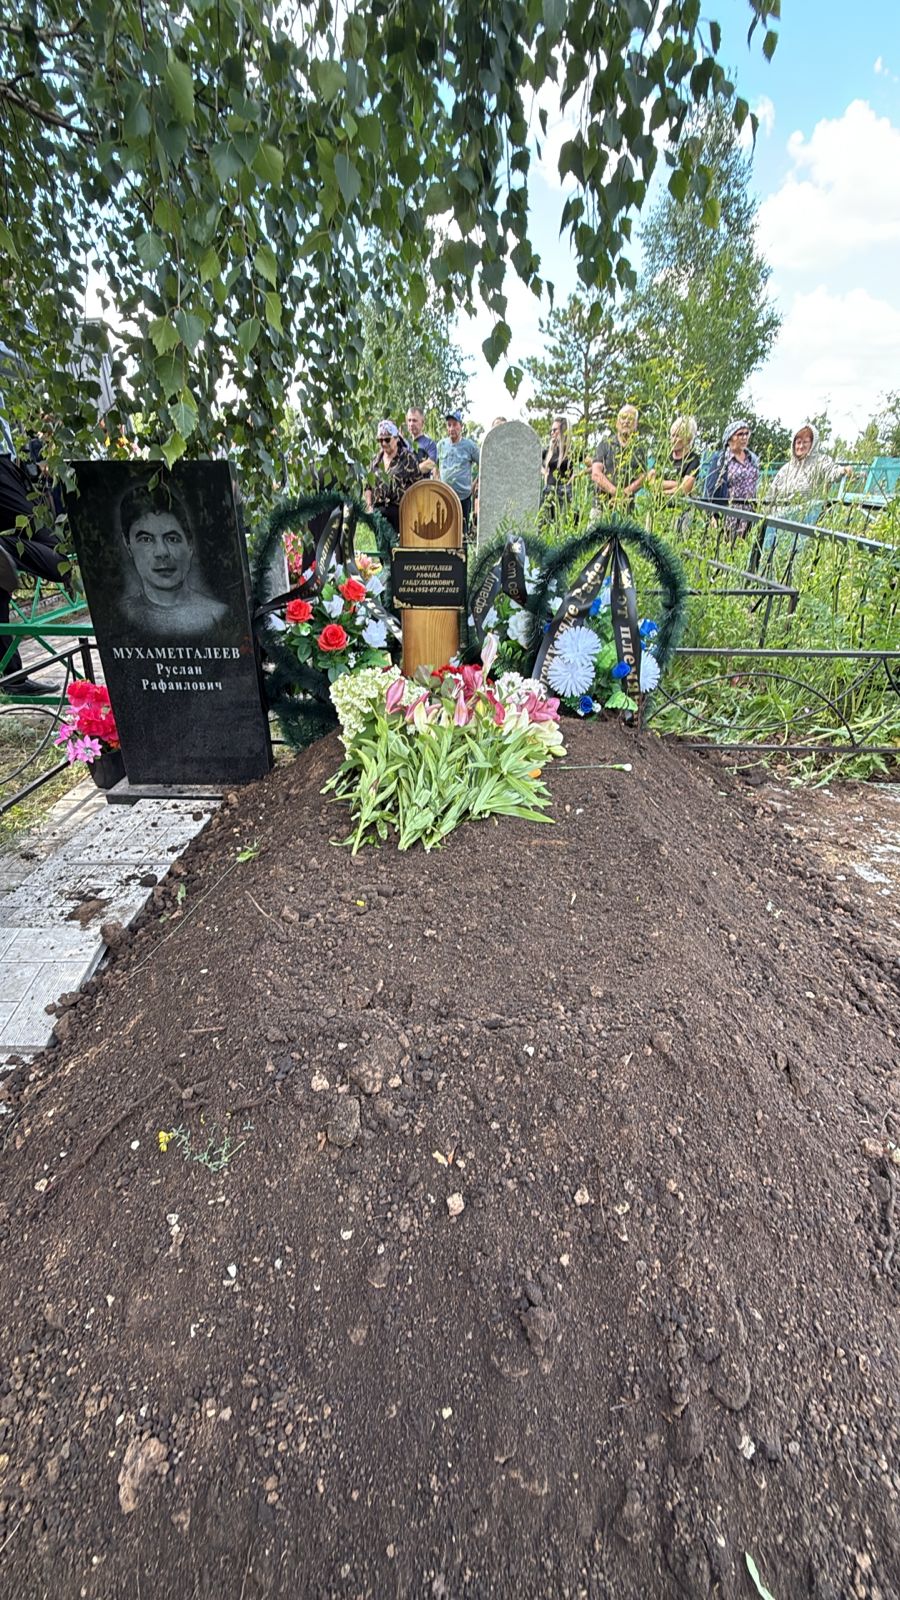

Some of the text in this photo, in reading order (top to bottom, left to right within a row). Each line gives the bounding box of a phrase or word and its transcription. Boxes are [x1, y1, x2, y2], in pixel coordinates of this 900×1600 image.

[572, 562, 604, 604] Рафе
[617, 594, 629, 619] от
[112, 647, 240, 659] МУХАМЕТГАЛЕЕВ
[156, 663, 202, 677] Руслан
[141, 679, 223, 693] Рафаилович
